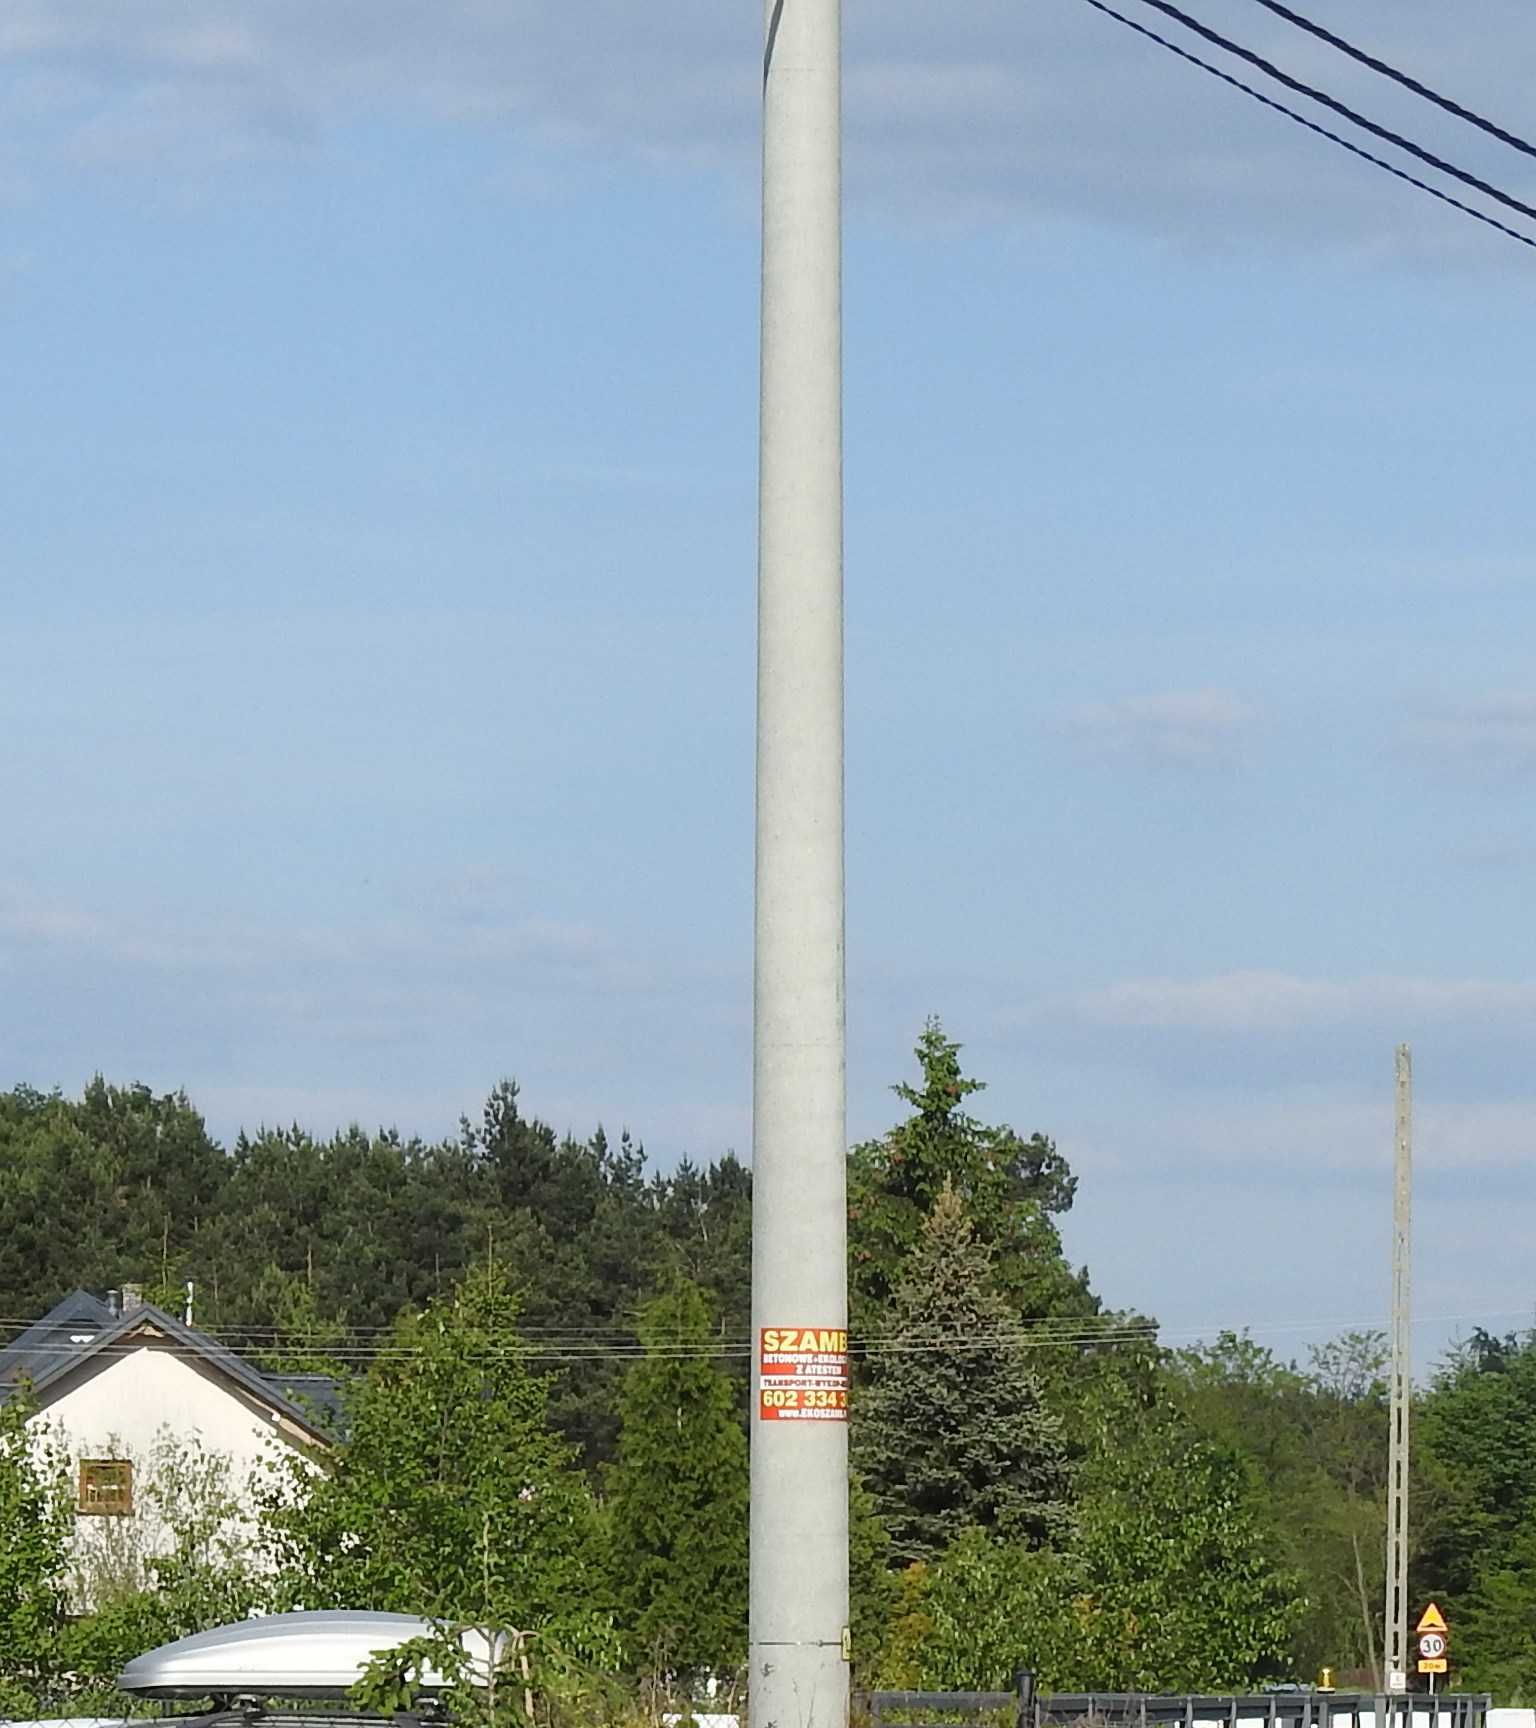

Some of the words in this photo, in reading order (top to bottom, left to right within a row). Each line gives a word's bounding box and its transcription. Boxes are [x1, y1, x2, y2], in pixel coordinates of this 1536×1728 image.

[763, 1391, 798, 1407] 602
[804, 1391, 838, 1407] 334
[1423, 1639, 1442, 1653] 30
